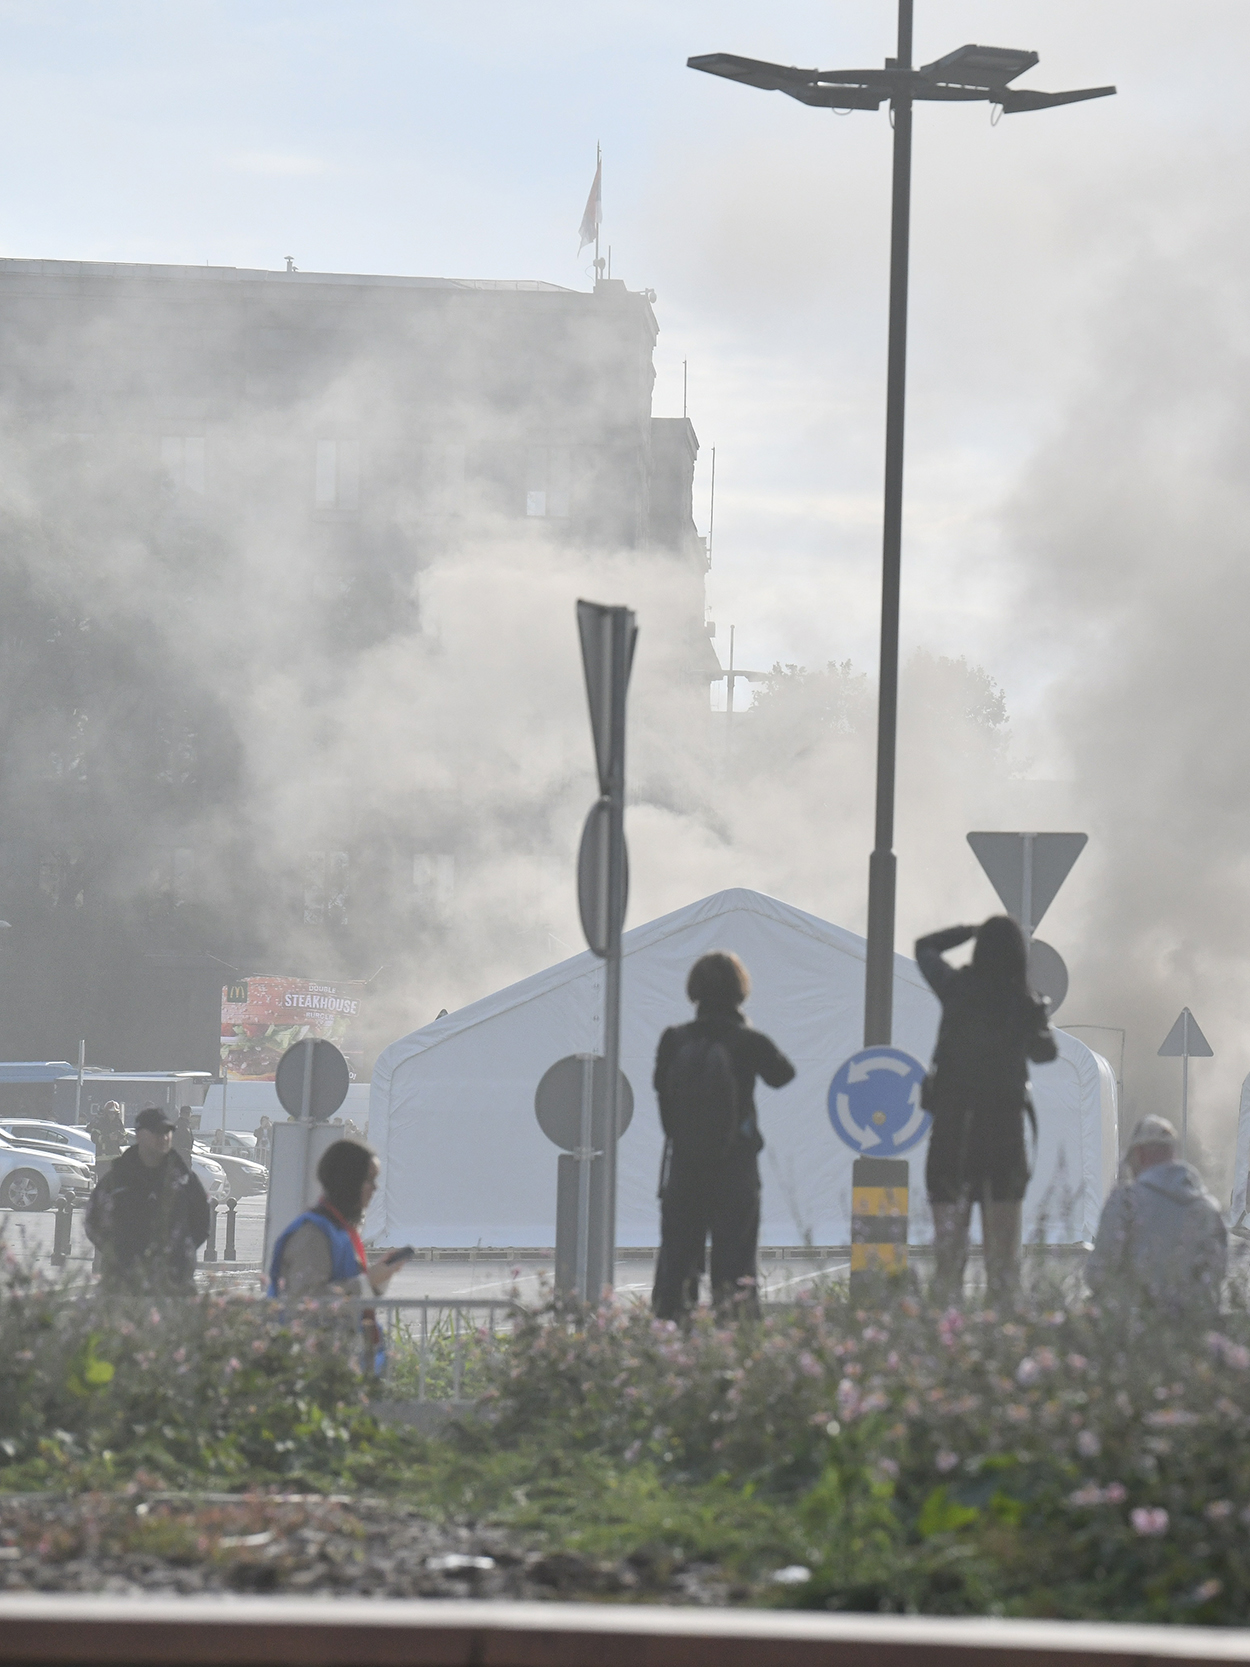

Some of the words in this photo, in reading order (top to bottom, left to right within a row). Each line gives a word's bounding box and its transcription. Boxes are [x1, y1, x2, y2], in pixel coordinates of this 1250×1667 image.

[308, 985, 336, 994] DOUBLE
[284, 994, 358, 1014] STEAKHOUSE
[305, 1012, 335, 1021] BURGER
